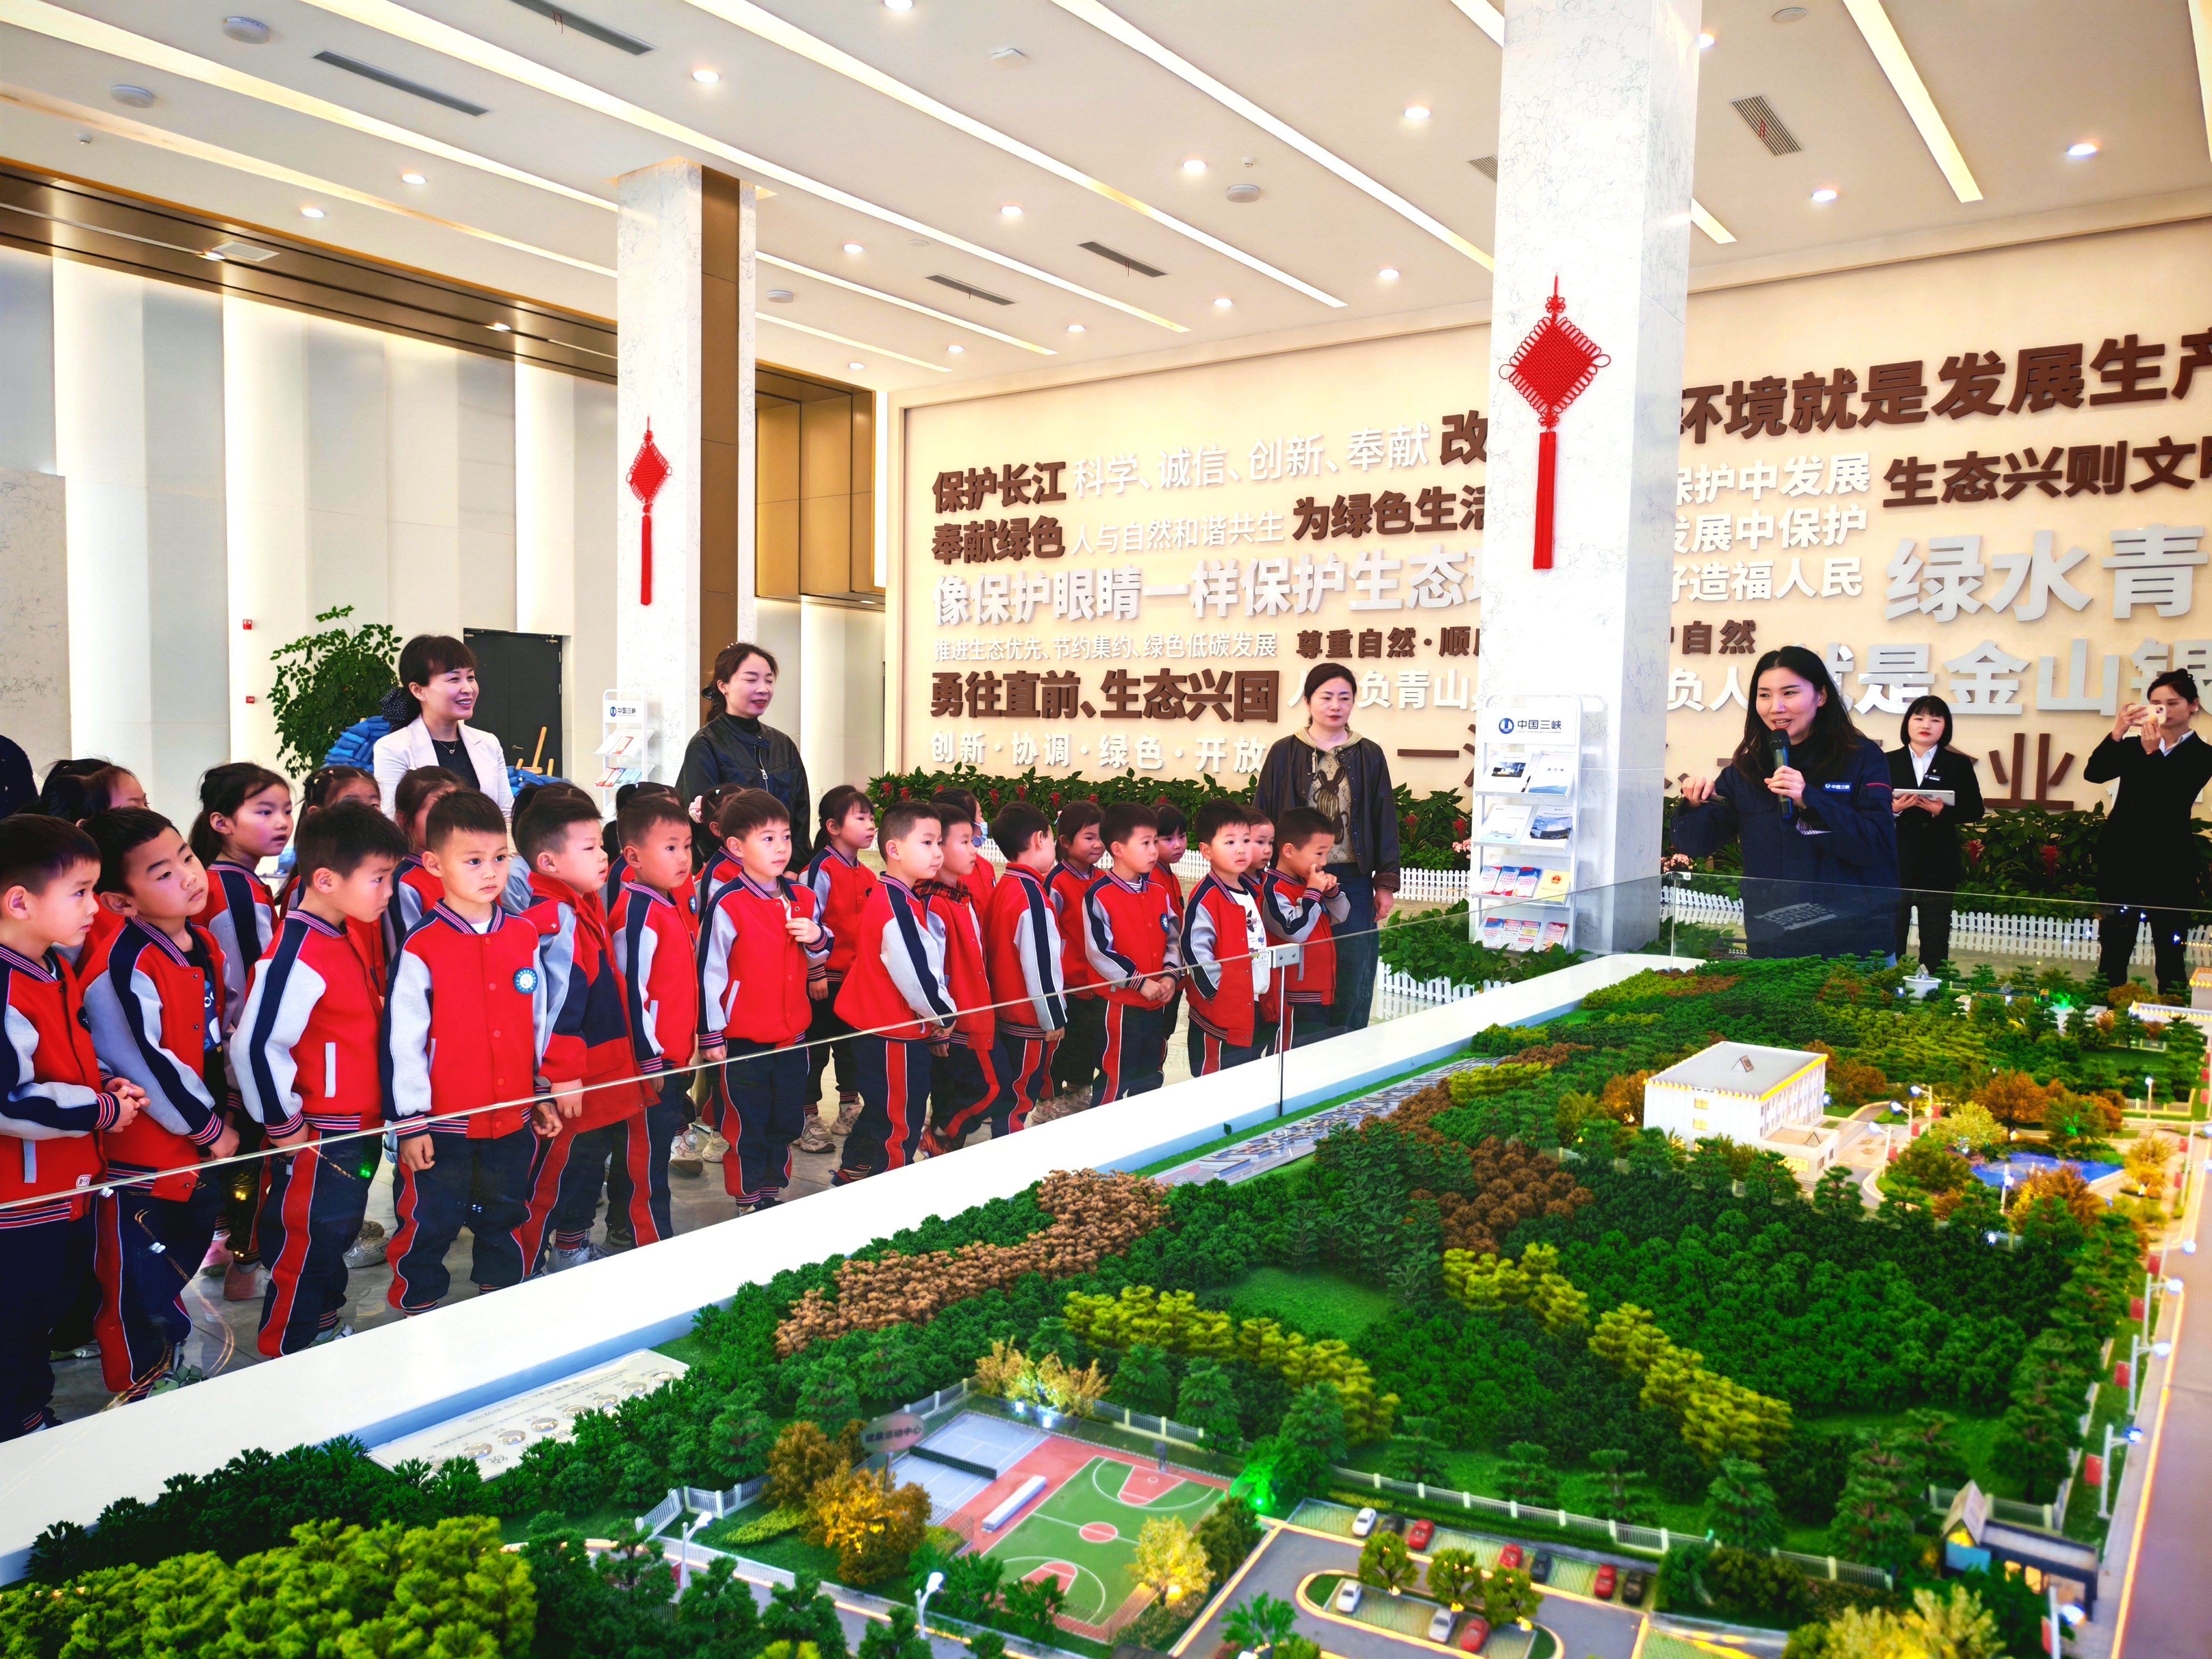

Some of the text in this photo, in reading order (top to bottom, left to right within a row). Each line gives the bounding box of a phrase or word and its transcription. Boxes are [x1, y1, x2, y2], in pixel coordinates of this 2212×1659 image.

[1072, 421, 1429, 498] 科学、诚信、创新、奉献
[1883, 435, 2212, 509] 生态兴则文
[932, 461, 1067, 514] 保护长江
[932, 515, 1065, 565] 奉献绿色
[1071, 510, 1284, 555] 人与自然和谐共生
[933, 544, 1481, 625] 像保护眼睛一样保护生态
[1885, 525, 2209, 623] 绿水青
[933, 631, 1277, 662] 推进生态优先、节约集约、绿色低碳发展
[1296, 626, 1480, 659] 尊重自然·顺
[1670, 619, 1756, 655] 自然
[930, 667, 1280, 723] 勇往直前、生态兴国
[1518, 720, 1561, 730] 中国三峡
